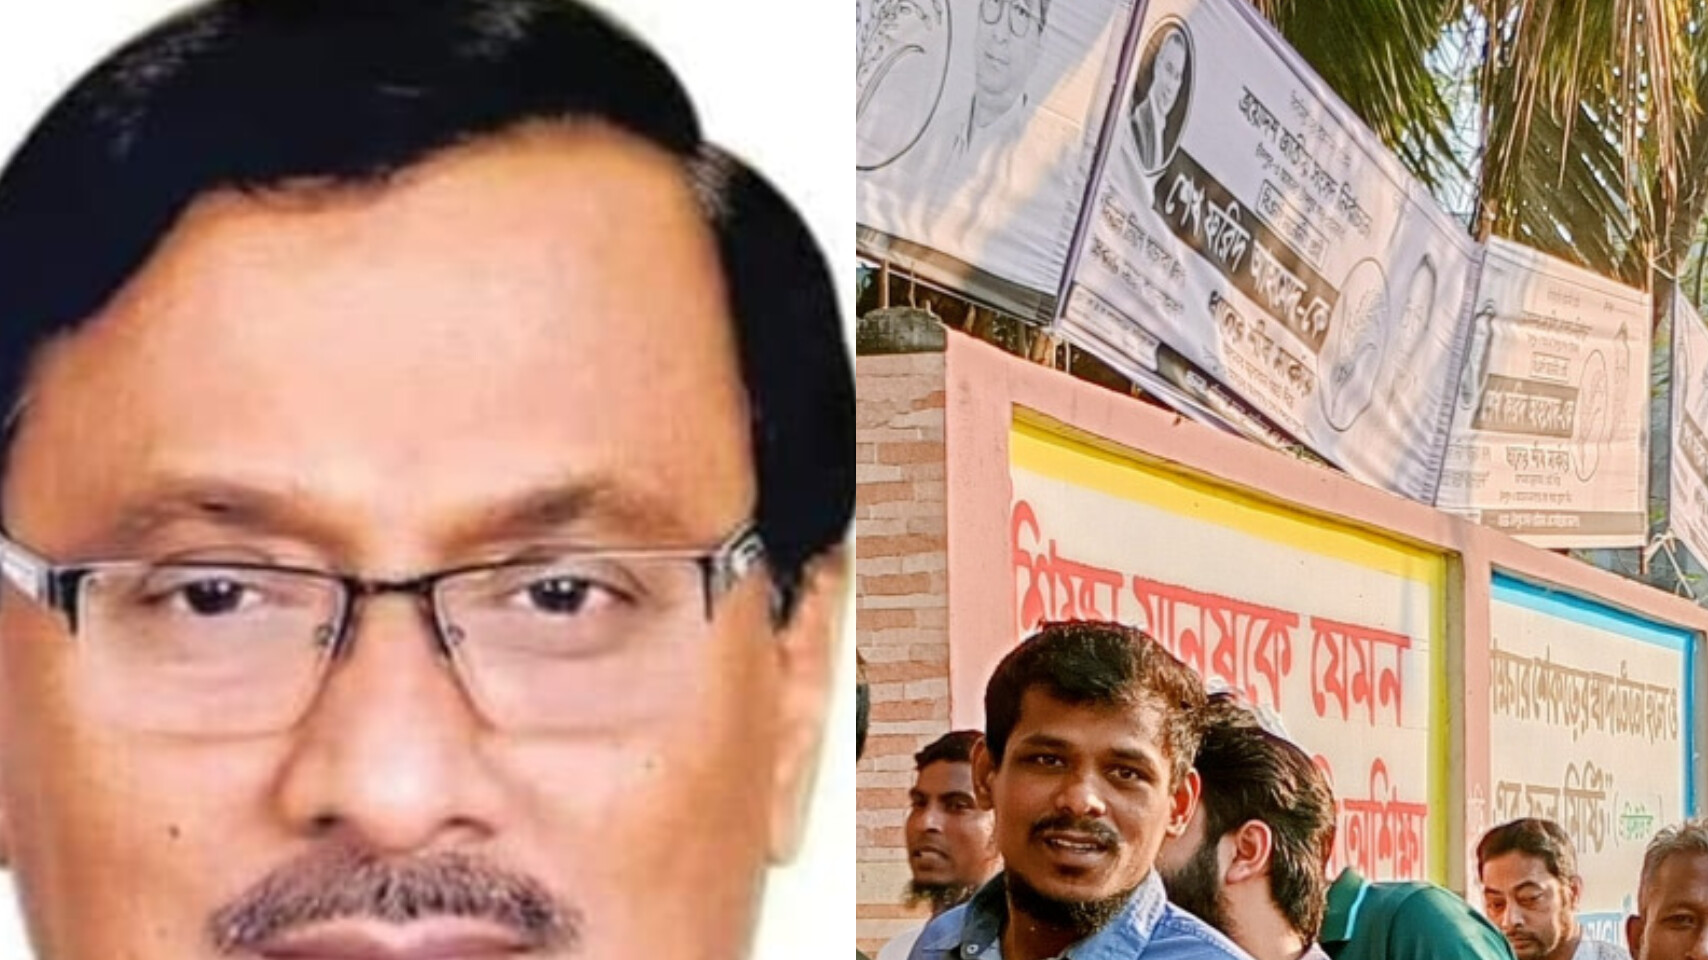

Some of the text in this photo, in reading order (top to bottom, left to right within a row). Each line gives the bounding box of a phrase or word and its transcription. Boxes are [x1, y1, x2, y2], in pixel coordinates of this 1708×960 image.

[1164, 172, 1206, 237] শেখ
[1204, 200, 1252, 273] ফরিদ
[1132, 574, 1300, 714] মানষকে
[1309, 615, 1411, 728] যেমন
